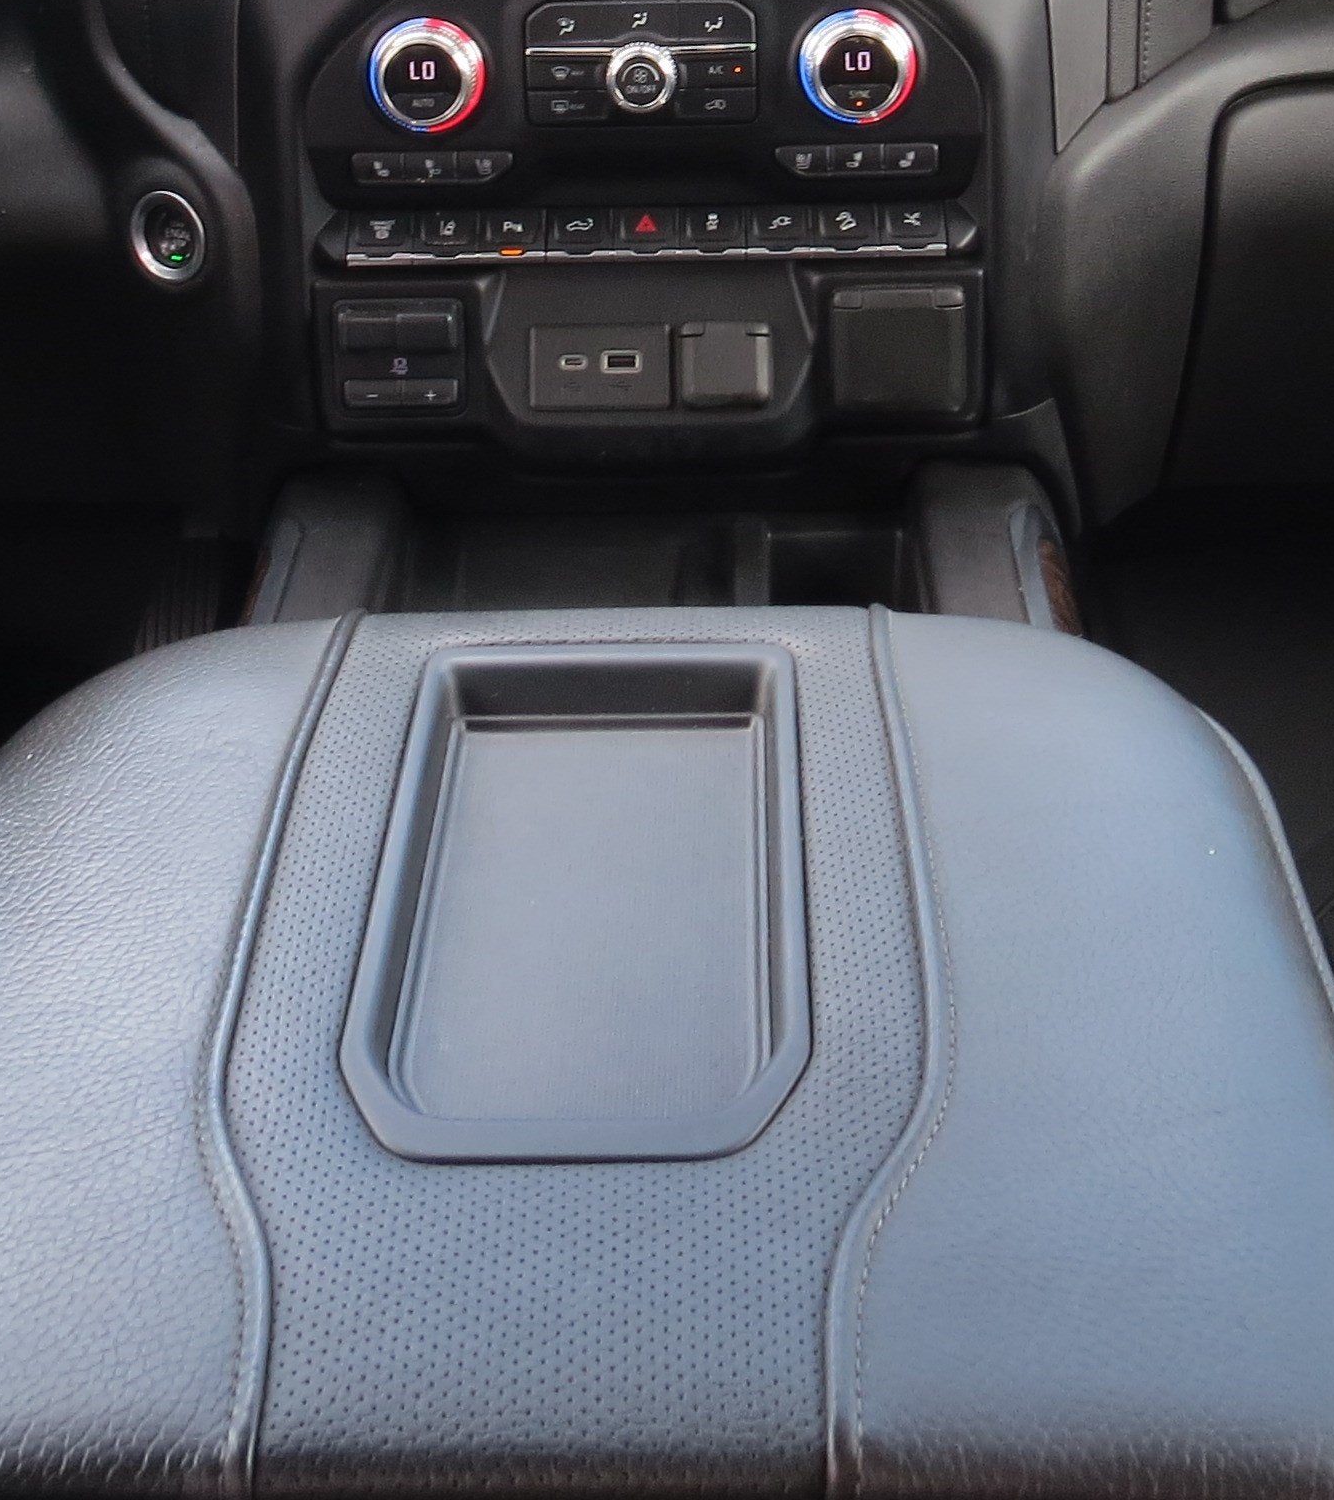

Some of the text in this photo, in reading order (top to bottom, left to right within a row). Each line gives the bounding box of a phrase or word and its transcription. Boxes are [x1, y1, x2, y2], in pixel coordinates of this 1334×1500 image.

[844, 51, 872, 71] LO
[409, 61, 436, 81] LO
[708, 65, 724, 75] A/C
[625, 85, 657, 95] ON/OFF
[411, 98, 436, 108] AUTO
